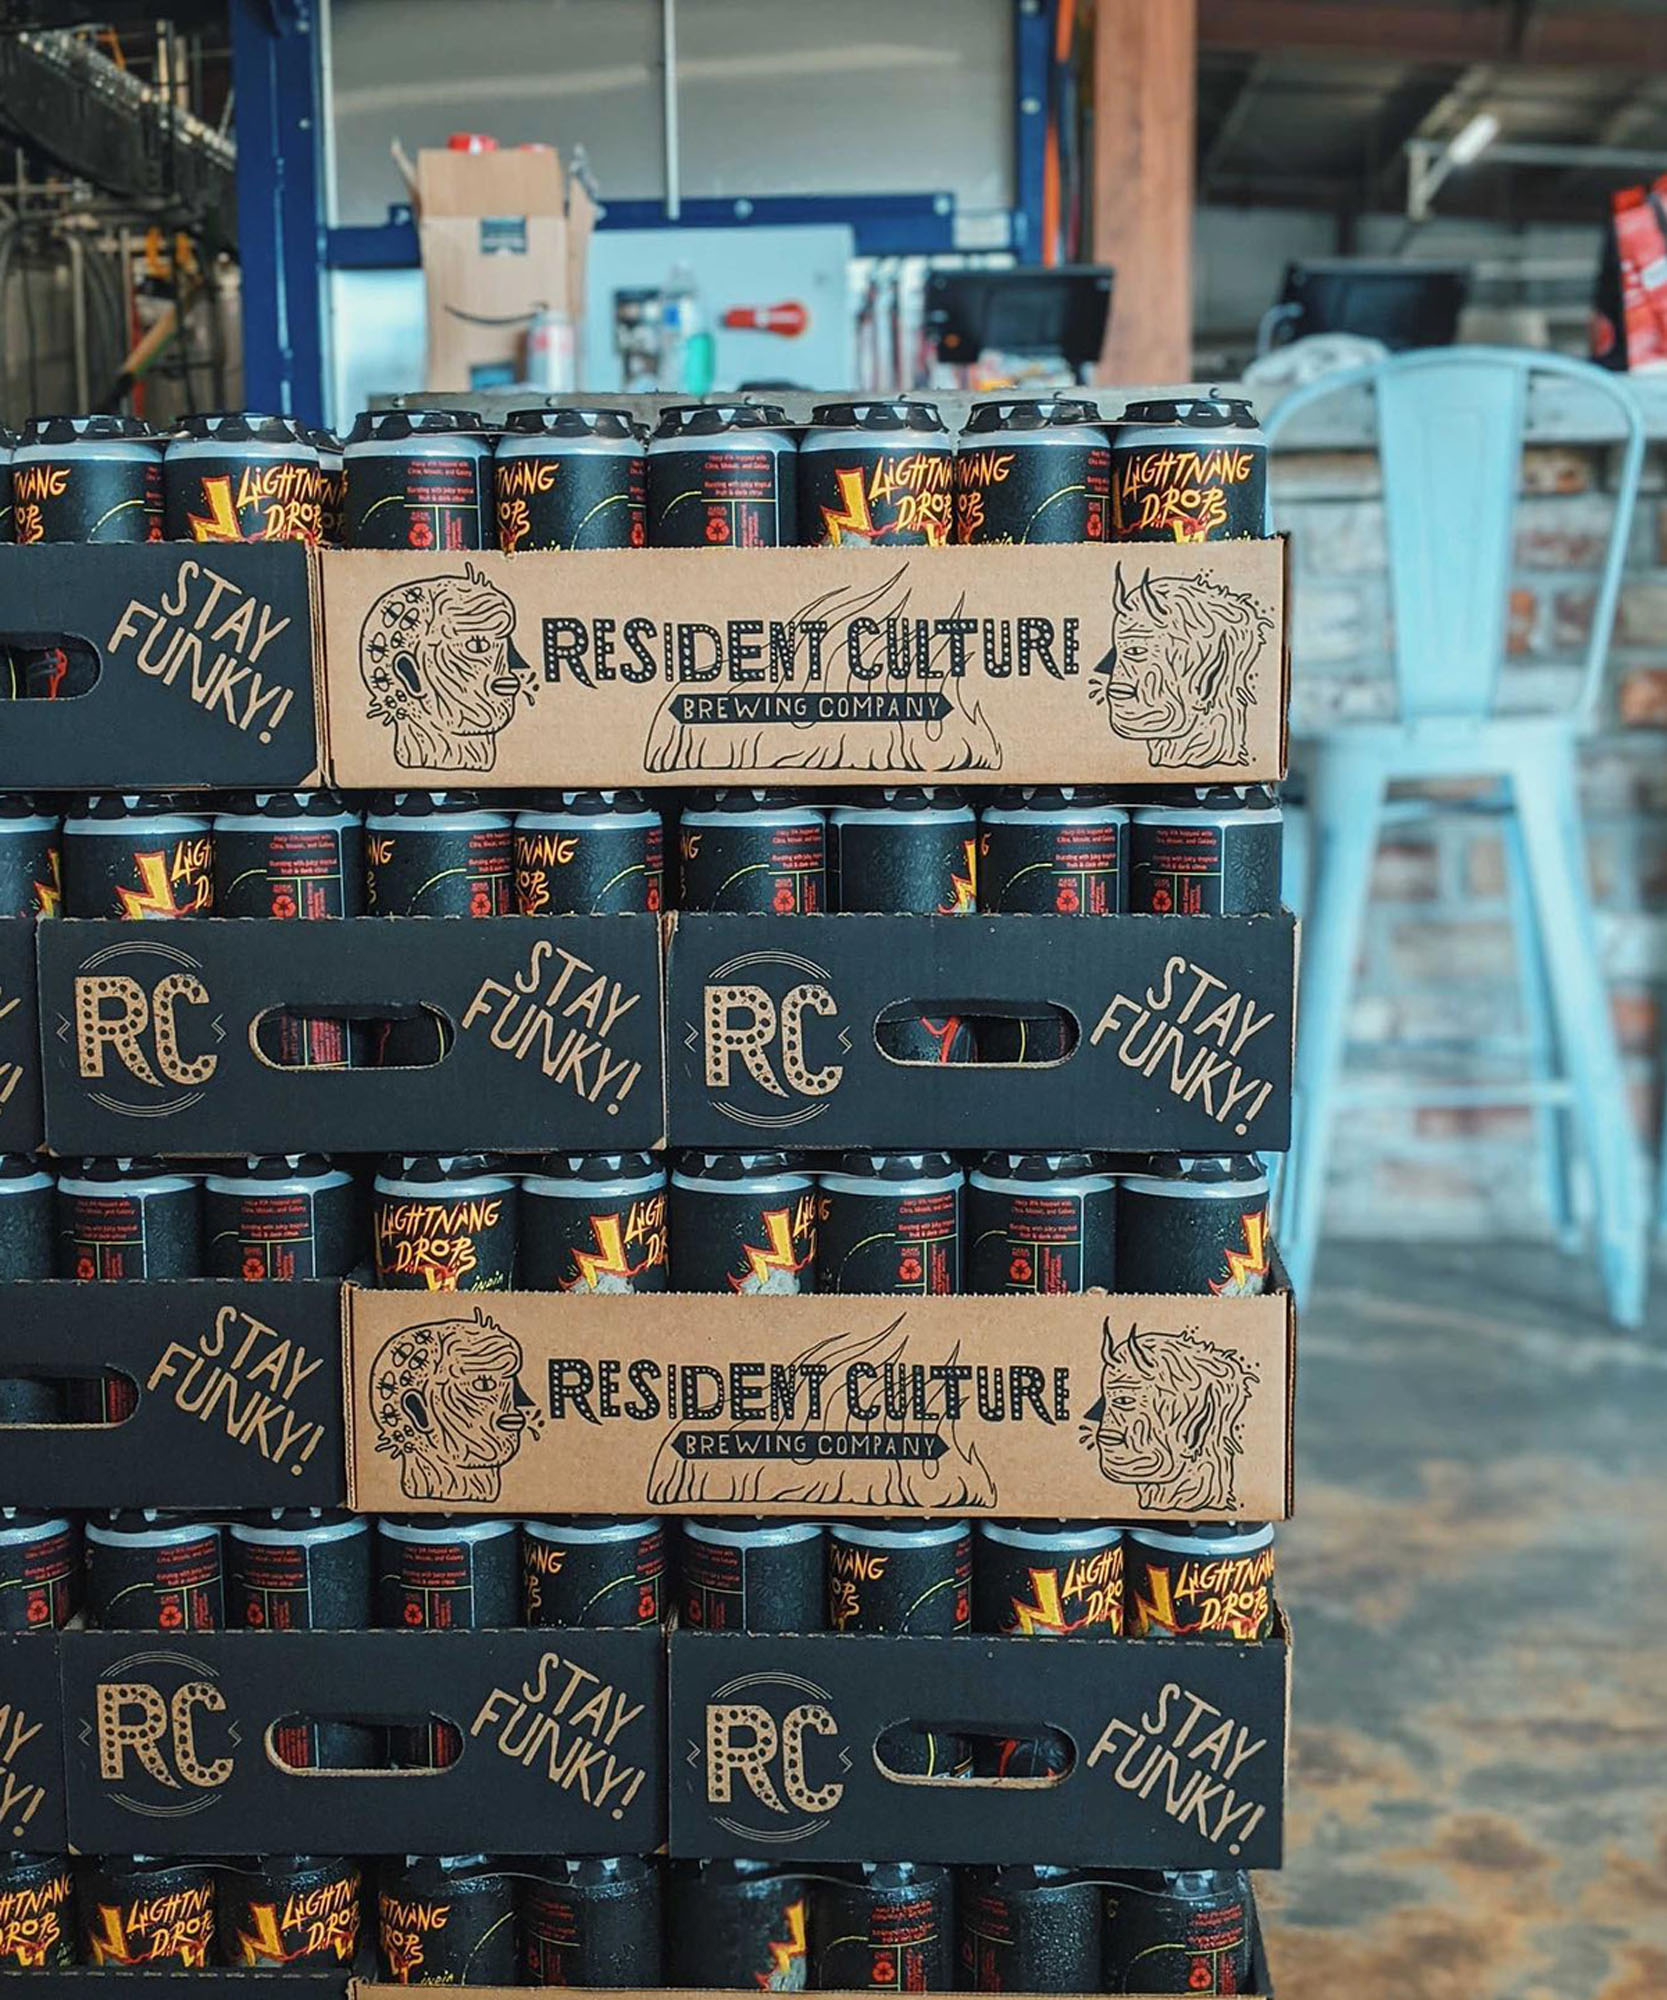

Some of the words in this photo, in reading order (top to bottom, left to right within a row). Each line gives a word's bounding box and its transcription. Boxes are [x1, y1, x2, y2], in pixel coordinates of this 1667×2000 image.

[1142, 487, 1229, 532] DROPS
[160, 560, 292, 663] STAY
[541, 617, 828, 689] RESIDENT
[847, 616, 1080, 681] CULTURE
[107, 600, 294, 743] FUNKY!
[684, 696, 807, 720] BREWING
[818, 695, 940, 719] COMPANY
[74, 973, 219, 1088] RC
[514, 940, 641, 1038] STAY
[1146, 955, 1275, 1056] STAY
[461, 977, 643, 1115] FUNKY!
[704, 984, 843, 1098] RC
[1090, 993, 1273, 1136] FUNKY!
[394, 1235, 478, 1274] DROPS
[200, 1305, 324, 1400] STAY
[548, 1358, 827, 1426] RESIDENT
[846, 1361, 1070, 1426] CULTURE
[147, 1342, 325, 1476] FUNKY!
[686, 1434, 807, 1455] BREWING
[818, 1434, 936, 1456] COMPANY
[97, 1682, 234, 1790] RC
[522, 1652, 645, 1745] STAY
[1141, 1682, 1267, 1780] STAY
[470, 1688, 646, 1820] FUNKY!
[706, 1703, 844, 1813] RC
[1086, 1717, 1266, 1856] FUNKY!
